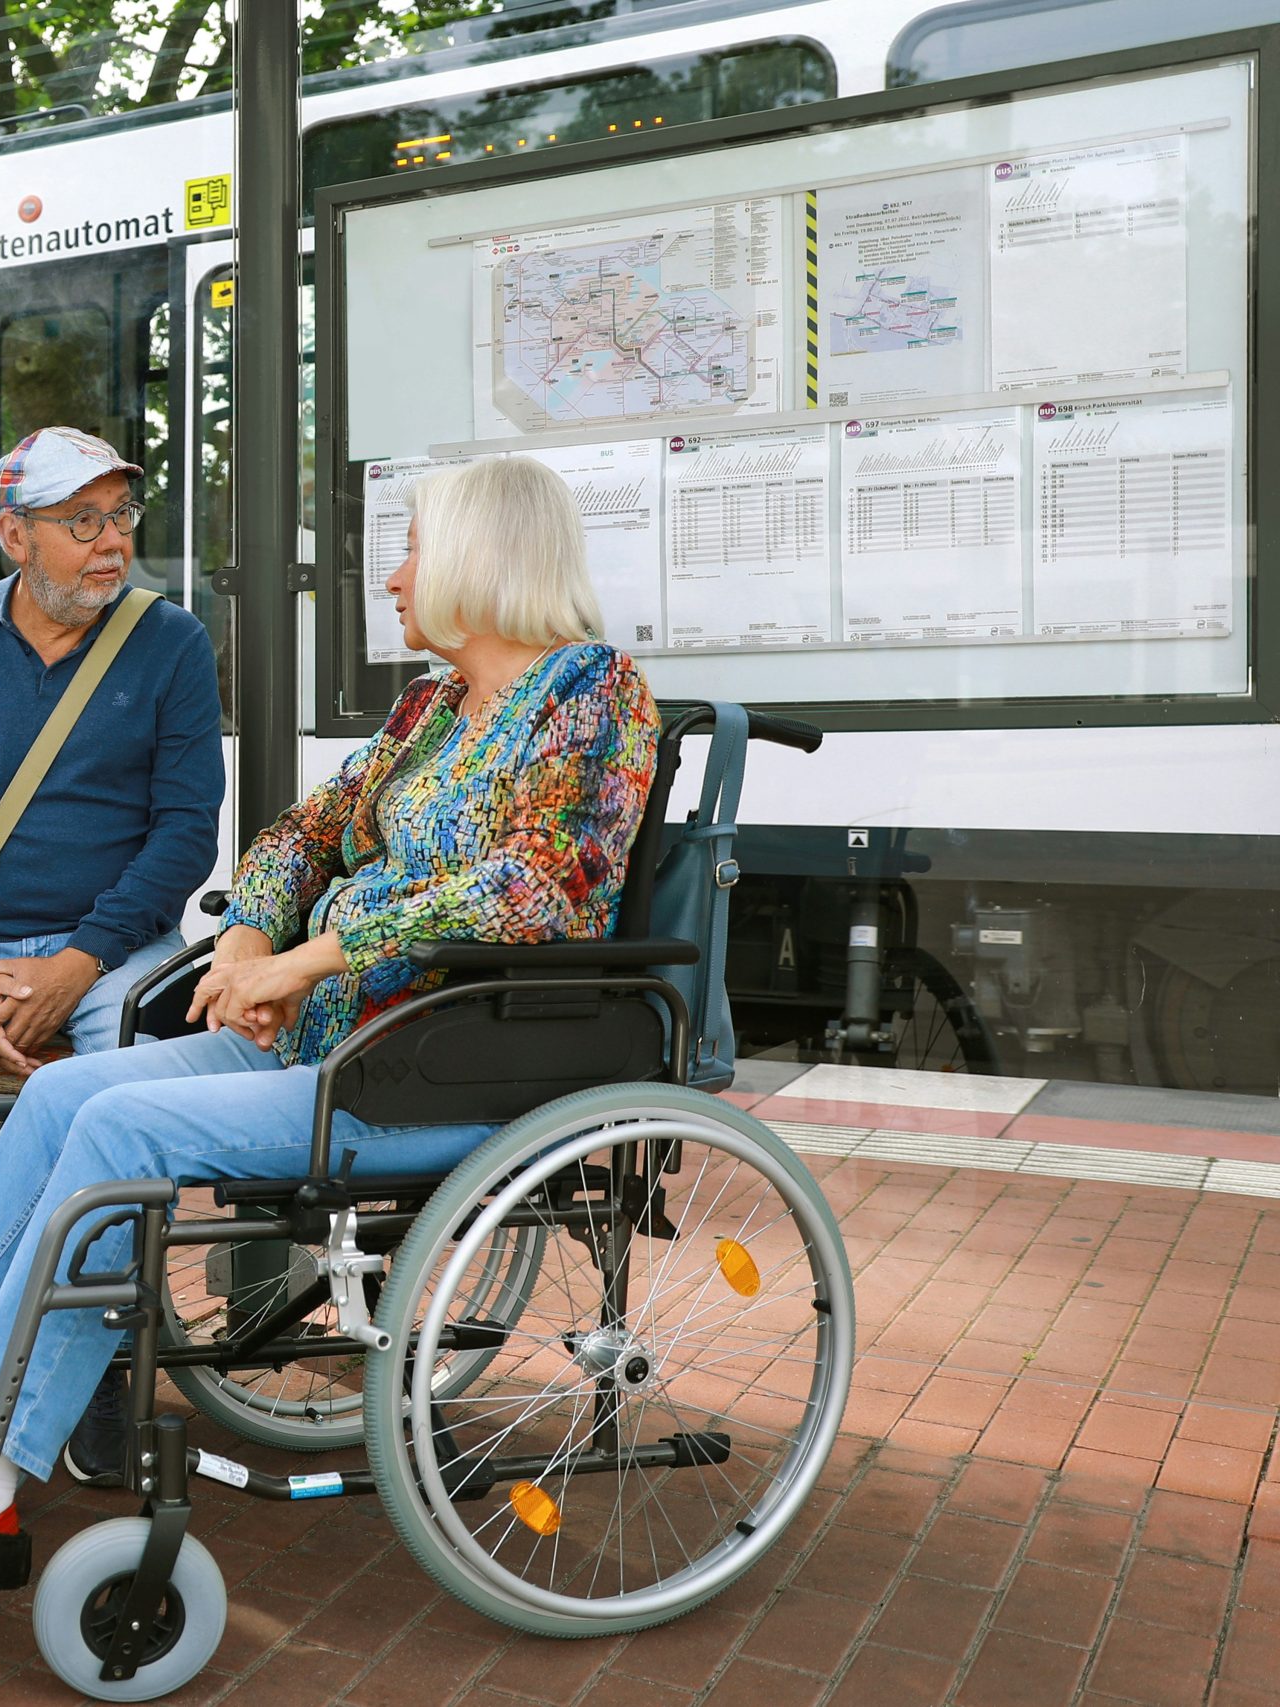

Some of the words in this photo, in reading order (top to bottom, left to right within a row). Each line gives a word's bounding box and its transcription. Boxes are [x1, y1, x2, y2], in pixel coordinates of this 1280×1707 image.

[995, 167, 1012, 176] BUS
[1014, 162, 1027, 171] N17
[1039, 407, 1056, 416] BUS
[1057, 404, 1074, 413] 698
[846, 425, 862, 434] BUS
[865, 420, 880, 429] 697
[688, 436, 702, 444] 692
[600, 449, 615, 457] BUS
[369, 468, 382, 476] BUS
[382, 464, 394, 472] 612
[778, 928, 795, 967] A
